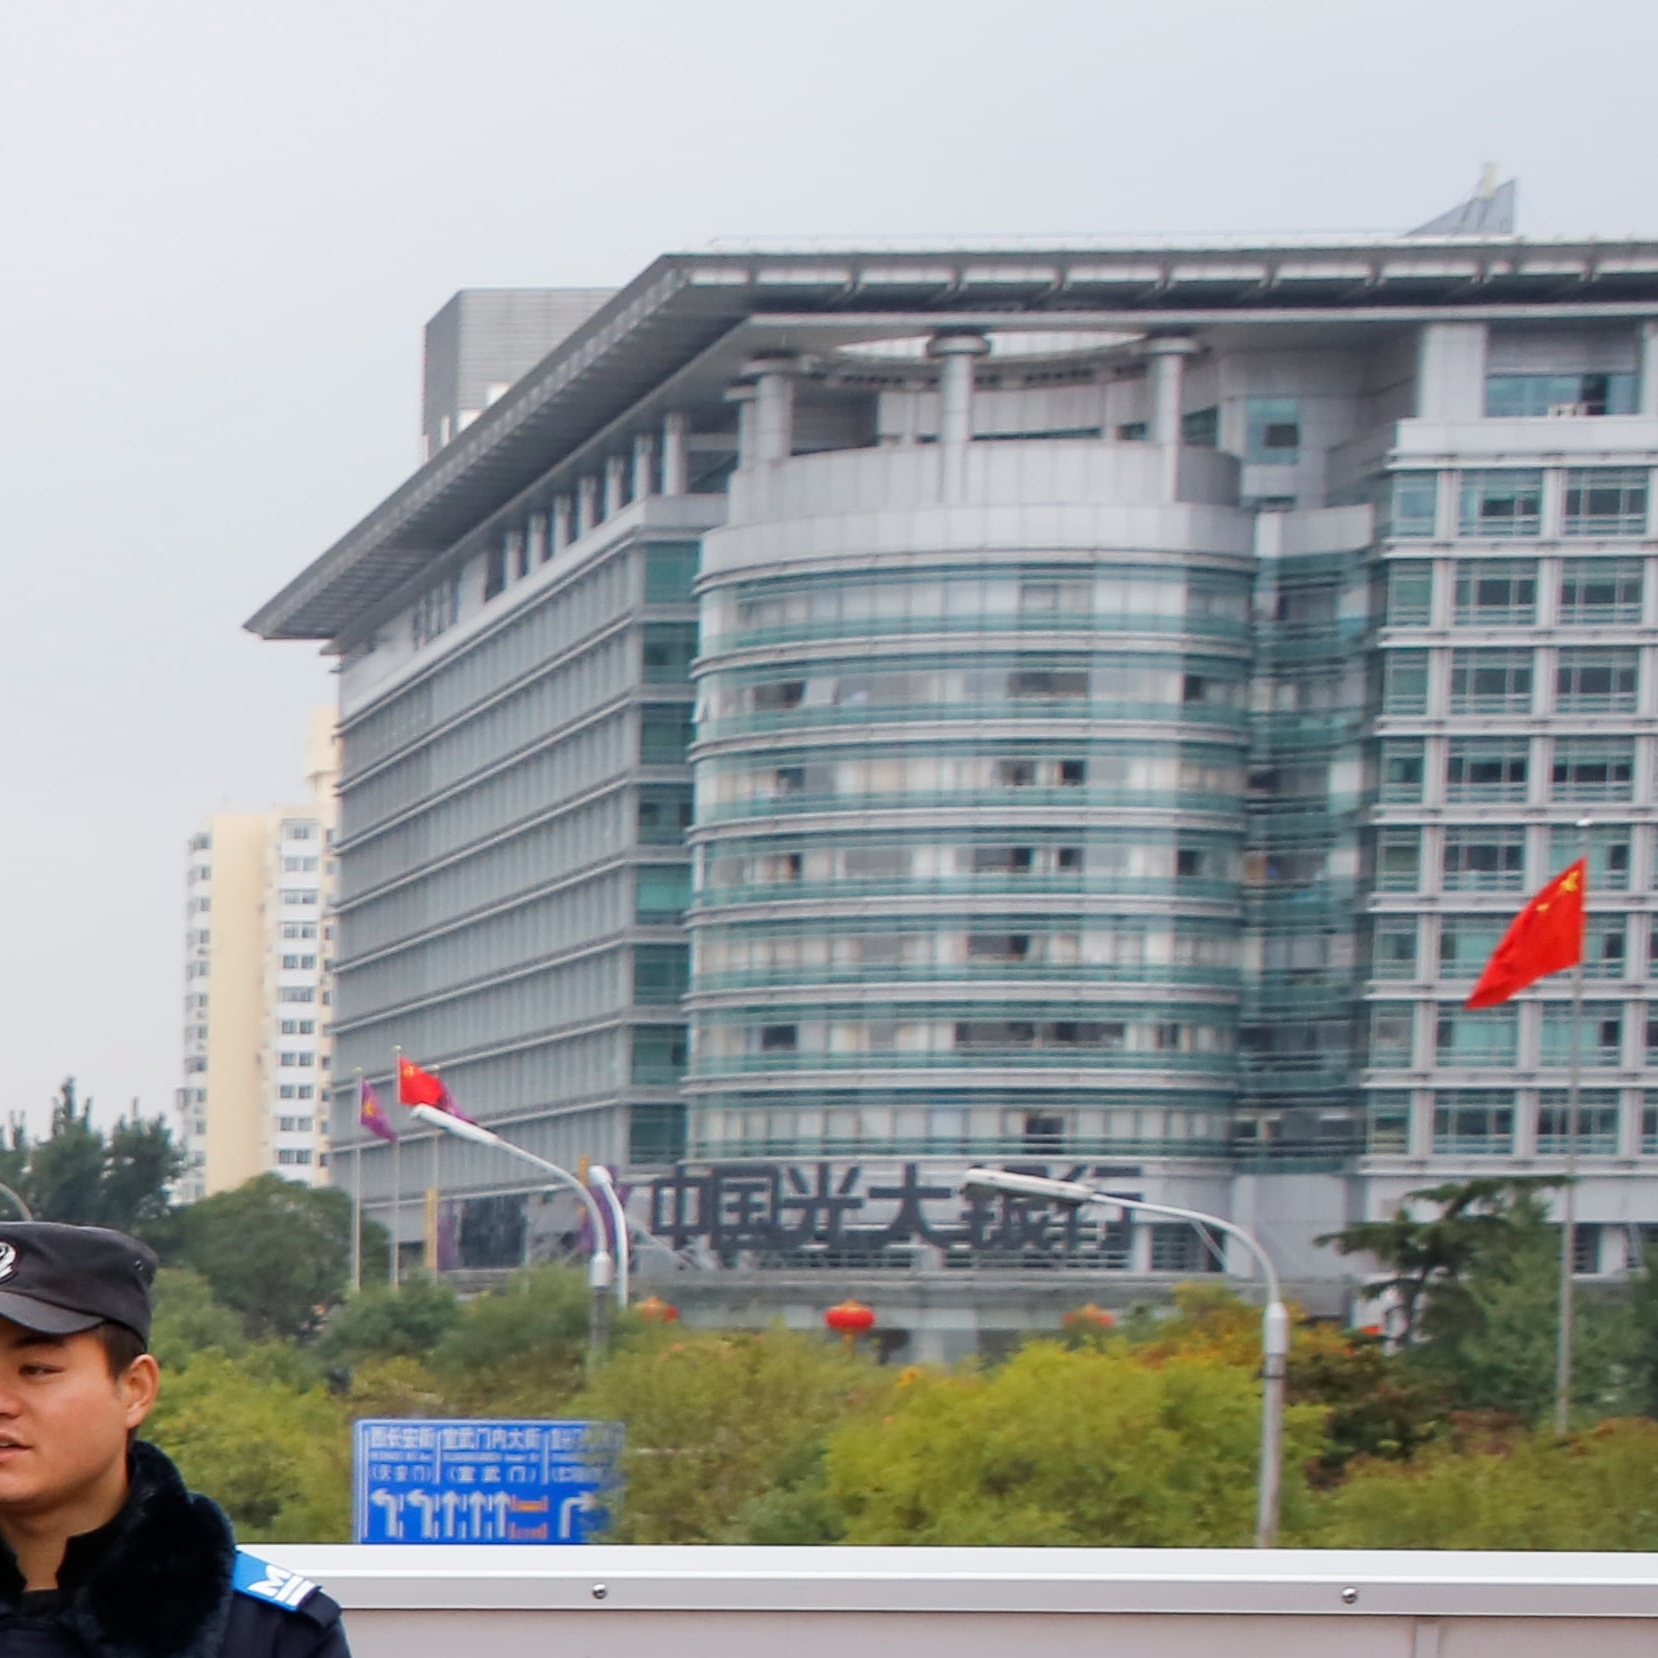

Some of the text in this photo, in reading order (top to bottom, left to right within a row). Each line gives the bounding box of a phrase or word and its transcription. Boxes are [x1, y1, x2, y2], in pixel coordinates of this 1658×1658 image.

[651, 1161, 1142, 1252] 中国光大银行
